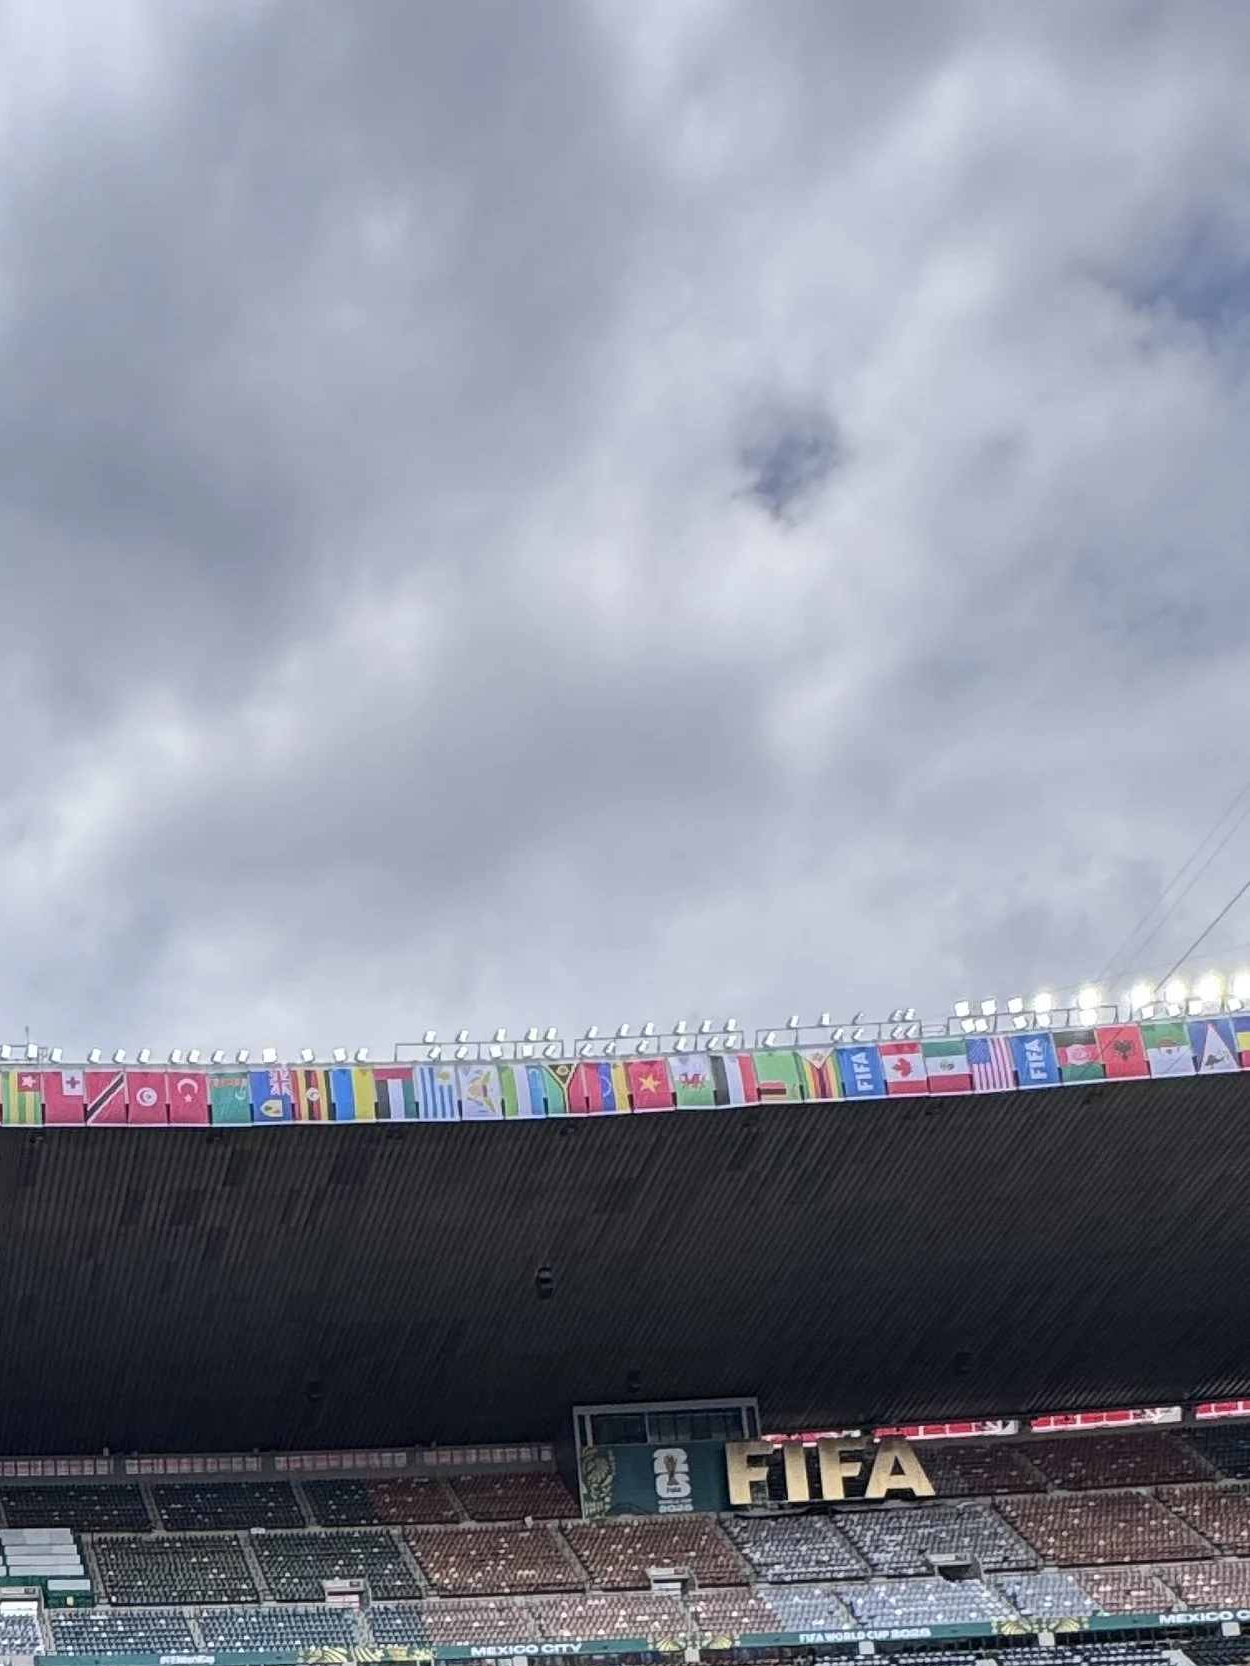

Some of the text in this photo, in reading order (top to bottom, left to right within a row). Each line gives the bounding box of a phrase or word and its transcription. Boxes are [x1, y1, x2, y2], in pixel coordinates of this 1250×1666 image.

[850, 1050, 875, 1092] FIFA
[1024, 1037, 1048, 1080] FIFA
[725, 1434, 937, 1505] FIFA
[1158, 1611, 1234, 1624] MEXICO
[470, 1643, 582, 1656] MEXICO CITY
[799, 1627, 932, 1644] FIFA WORLD CUP 2026
